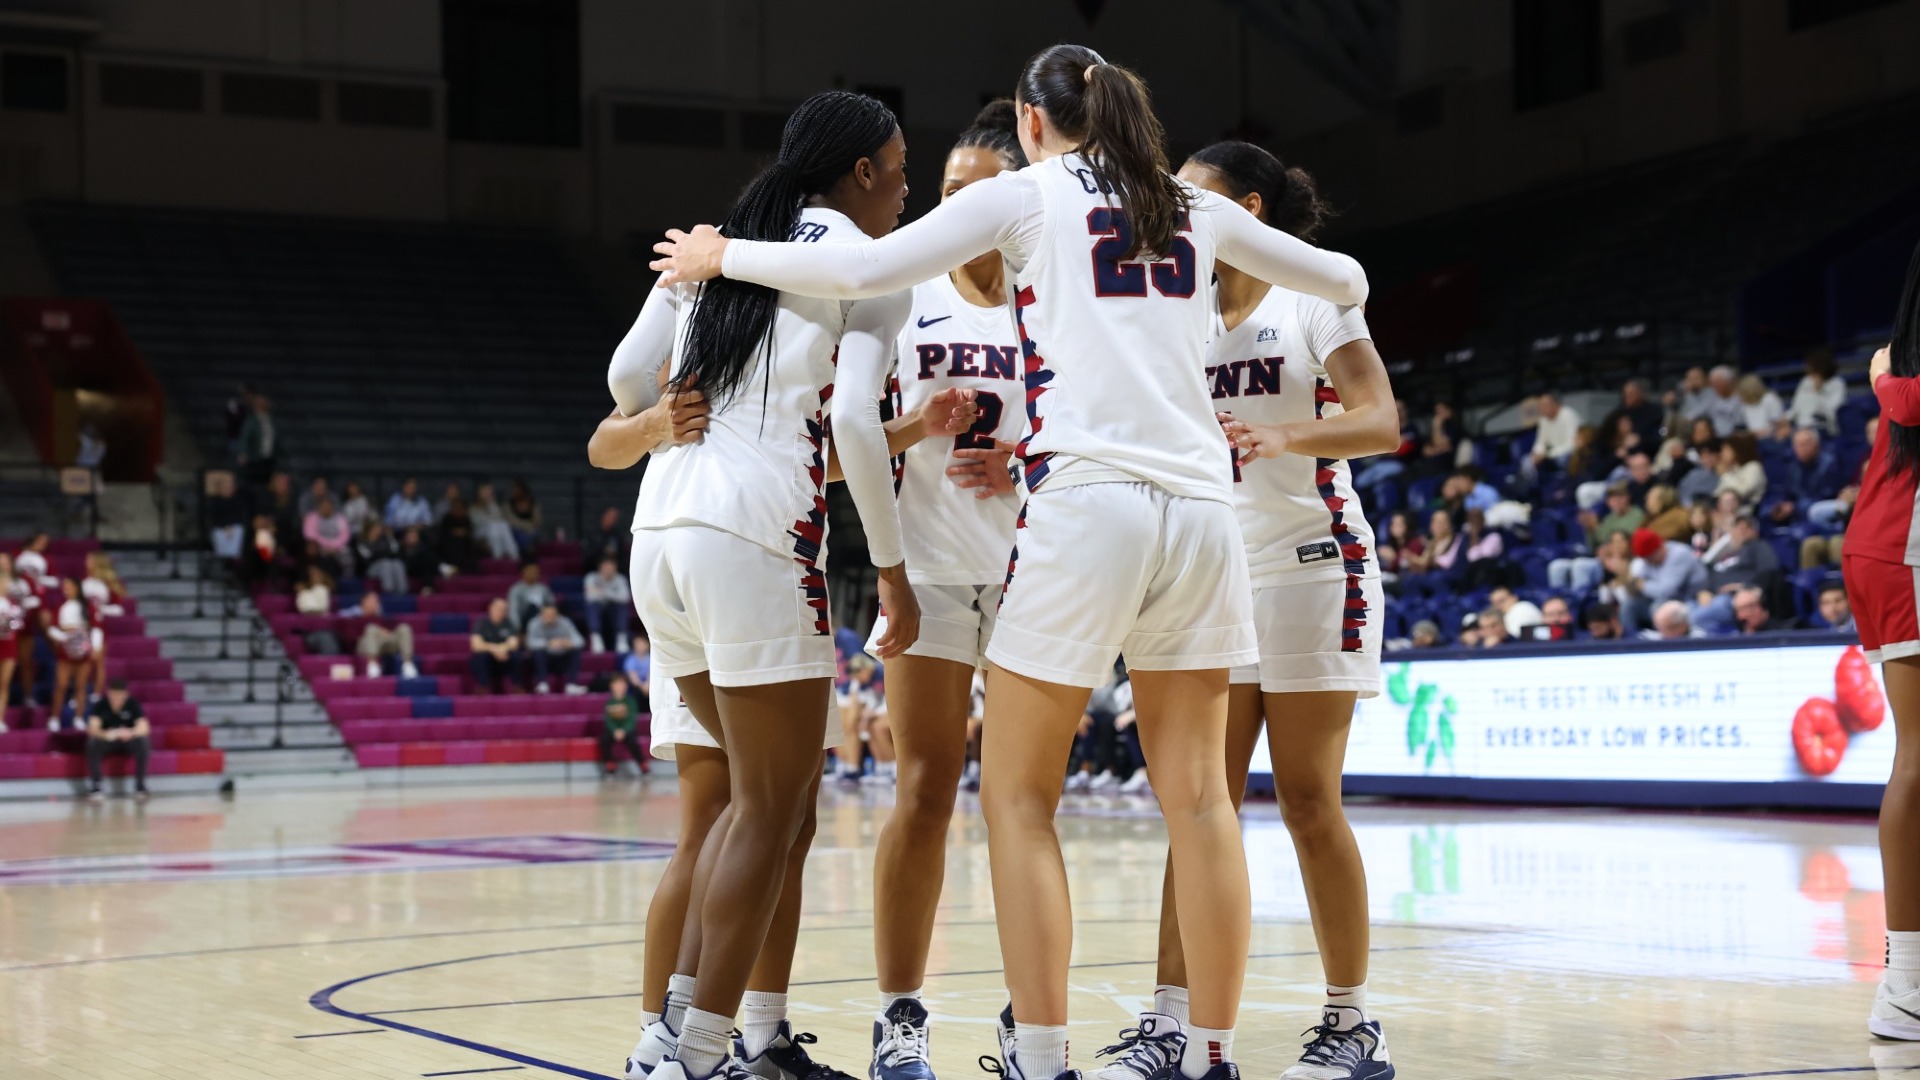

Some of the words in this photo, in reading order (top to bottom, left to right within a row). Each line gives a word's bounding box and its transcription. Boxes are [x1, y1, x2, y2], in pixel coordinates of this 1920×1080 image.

[1086, 207, 1196, 299] 25
[916, 343, 1024, 381] PEN
[1629, 683, 1700, 707] FRESH
[1485, 726, 1592, 747] EVERYDAY
[1601, 726, 1647, 747] LOW
